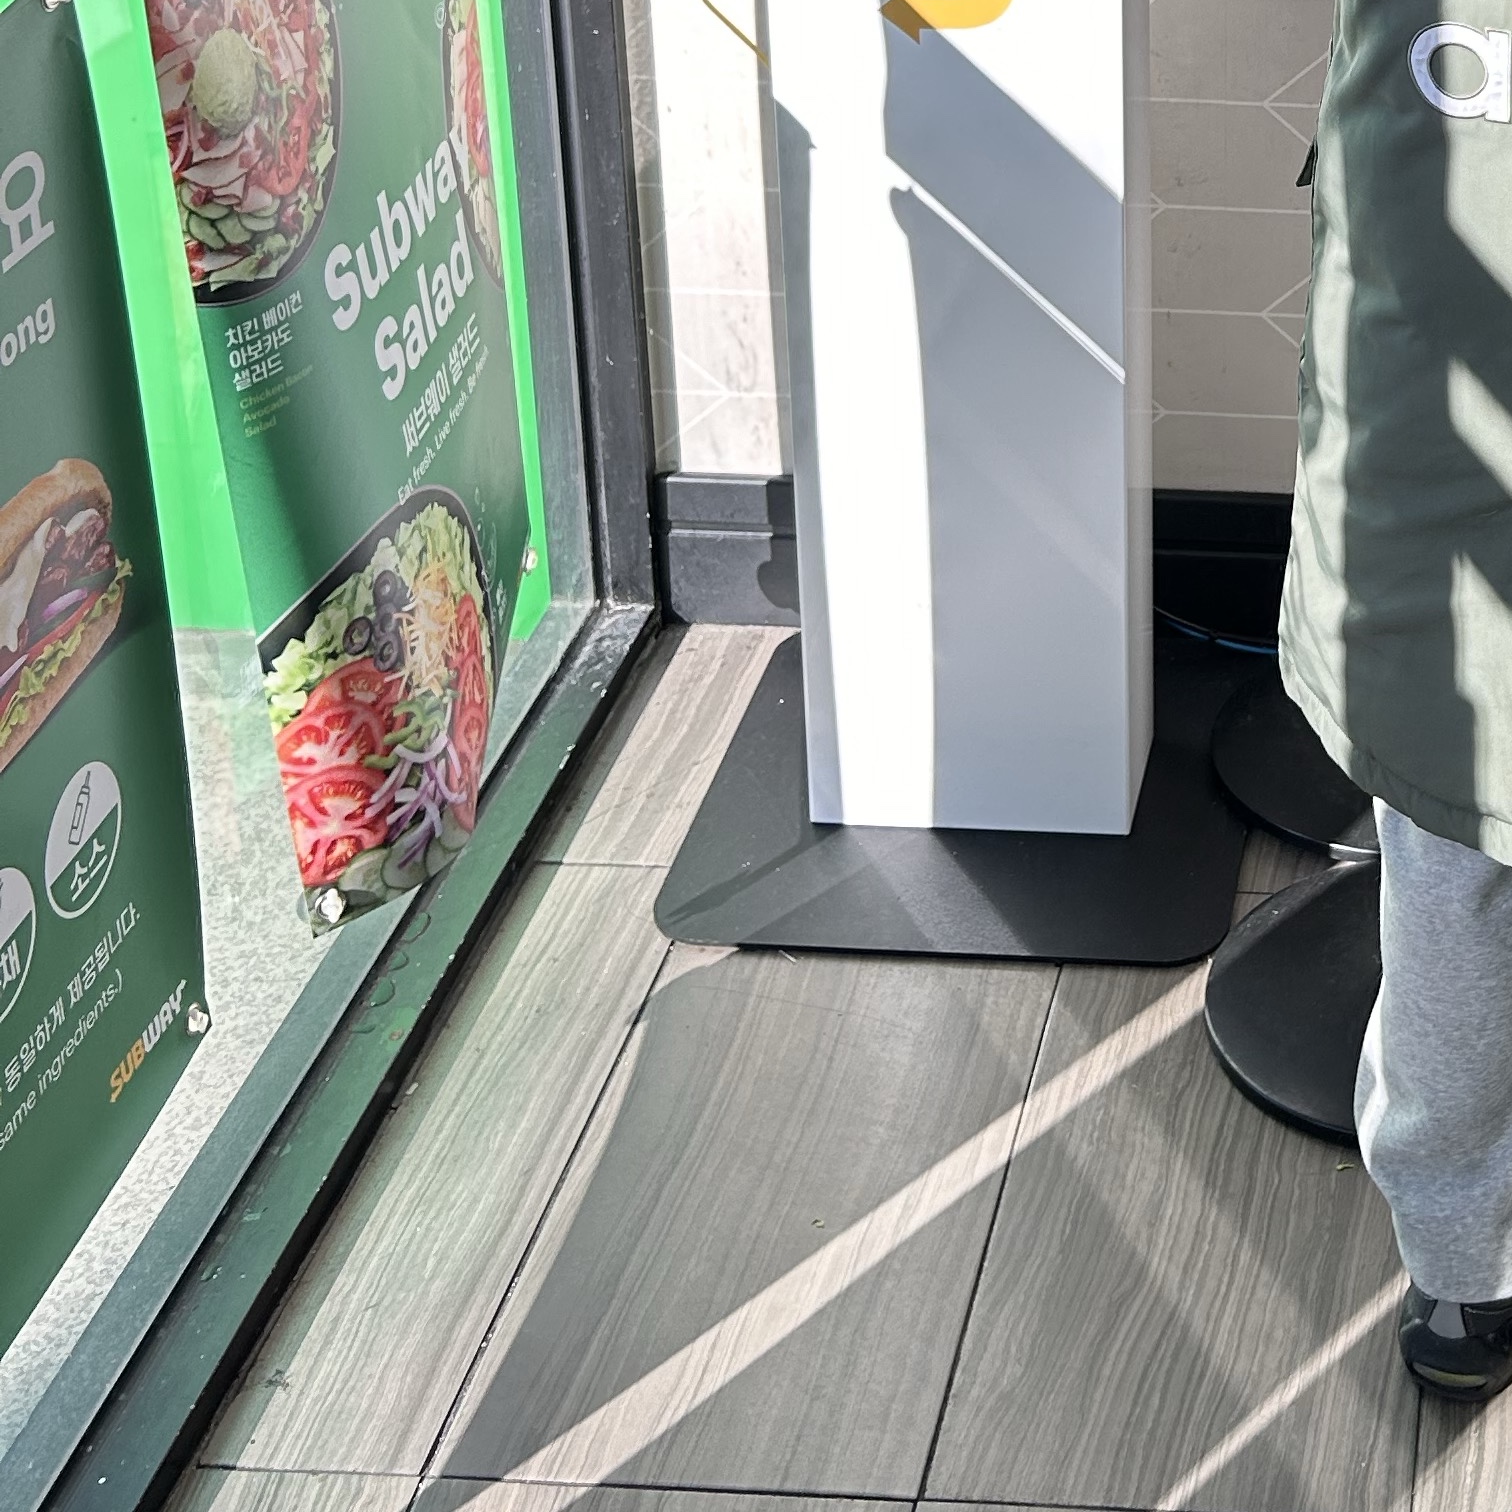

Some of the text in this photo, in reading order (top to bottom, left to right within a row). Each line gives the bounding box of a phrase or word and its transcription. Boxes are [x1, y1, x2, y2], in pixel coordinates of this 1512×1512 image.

[324, 113, 471, 331] Subway
[225, 290, 303, 348] 치킨 베이컨
[375, 207, 475, 401] Salad
[229, 322, 293, 369] 아보카도
[233, 352, 285, 392] 샐러드
[239, 381, 285, 409] Chicken
[243, 394, 291, 424] Avocado
[402, 312, 481, 458] 써브웨이 샐러드
[244, 416, 277, 438] Salad
[397, 477, 415, 506] Eat
[434, 421, 451, 450] Live
[70, 838, 108, 903] 소스
[4, 901, 141, 1093] 동일하게 제공됩니다.
[109, 979, 188, 1104] SUBWAY
